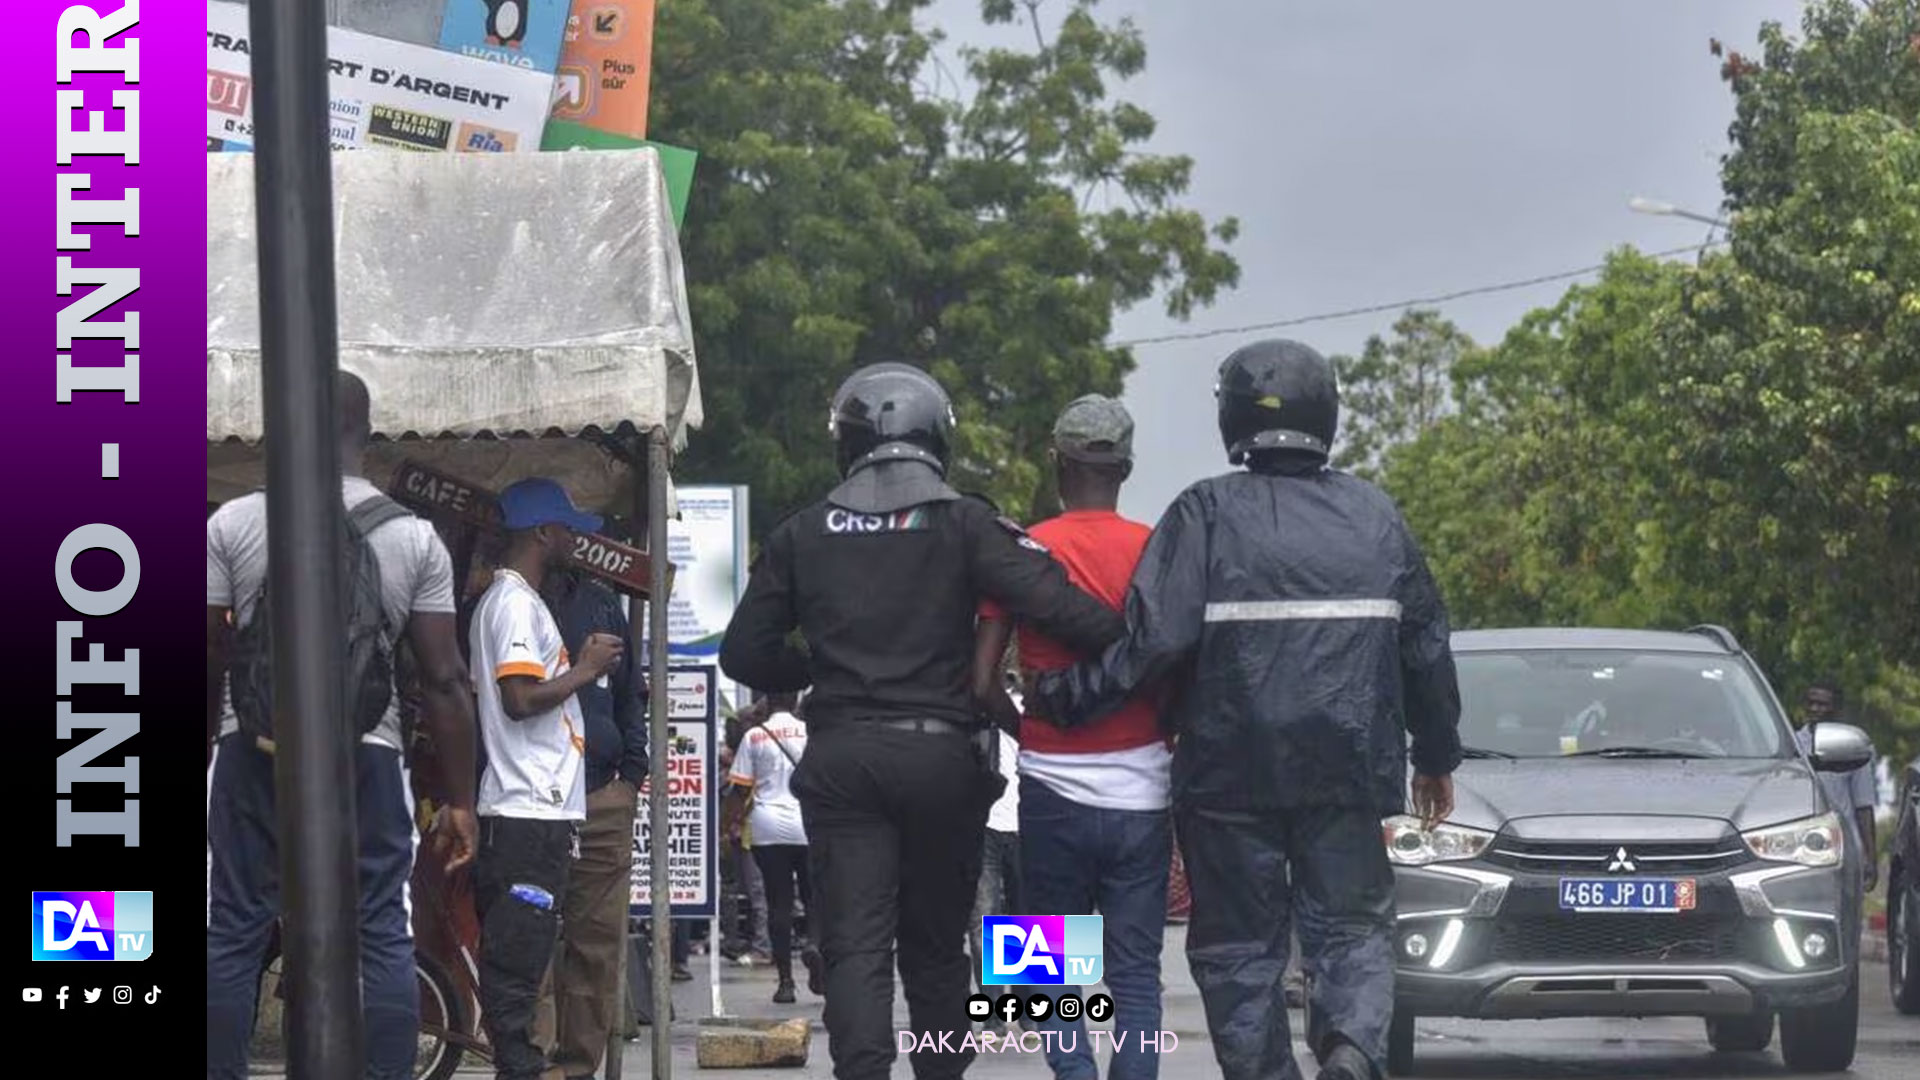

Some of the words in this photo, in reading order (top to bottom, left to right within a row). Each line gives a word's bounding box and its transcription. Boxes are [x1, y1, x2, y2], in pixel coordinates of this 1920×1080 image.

[602, 59, 635, 75] Plus
[369, 68, 509, 110] D'ARGENT
[601, 76, 627, 90] sûr
[373, 106, 440, 134] WESTERN
[391, 121, 438, 139] UNION
[467, 131, 503, 151] Ria
[1564, 882, 1605, 905] 466
[1611, 883, 1636, 905] JP
[1642, 883, 1667, 906] 01
